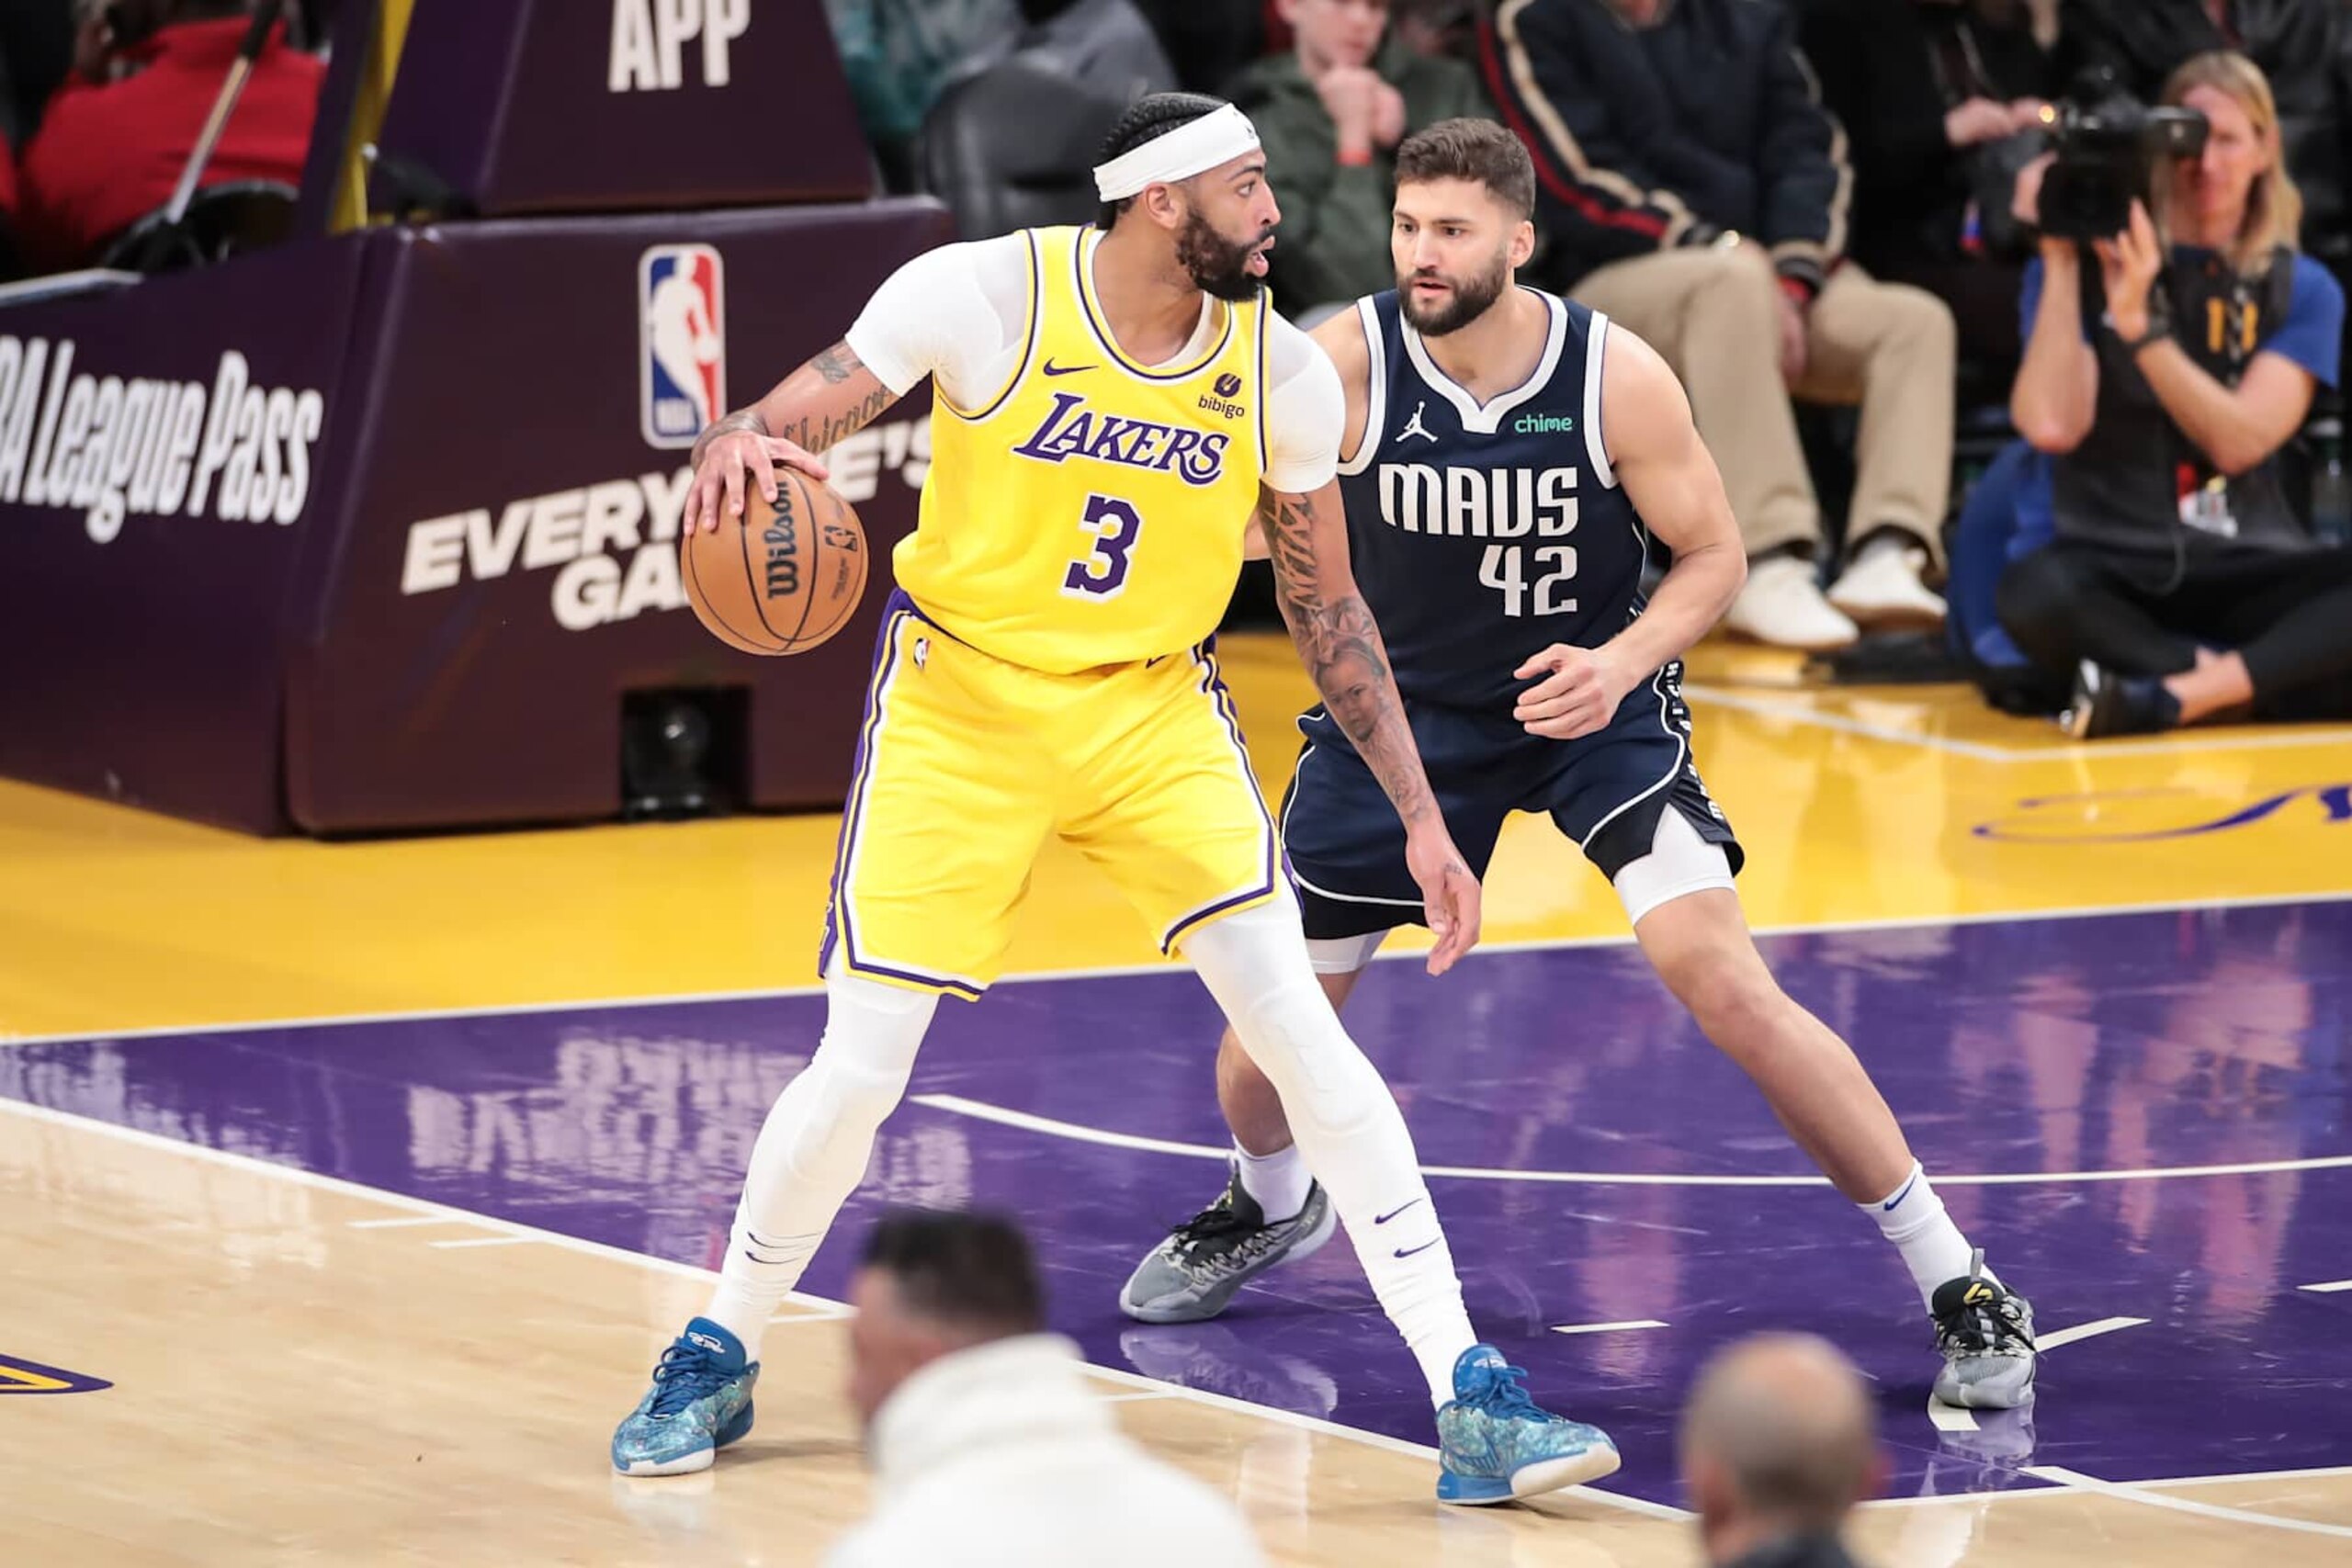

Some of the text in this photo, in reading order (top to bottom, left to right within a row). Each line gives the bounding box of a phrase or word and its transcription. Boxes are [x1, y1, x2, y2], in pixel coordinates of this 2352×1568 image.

[608, 0, 751, 93] APP
[22, 337, 207, 544] League
[187, 349, 323, 525] Pass
[1012, 391, 1229, 486] LAKERS
[1198, 395, 1245, 419] bibigo
[1515, 413, 1573, 433] chime
[1379, 463, 1579, 537] MAVS
[1063, 493, 1141, 597] 3
[1478, 544, 1578, 617] 42
